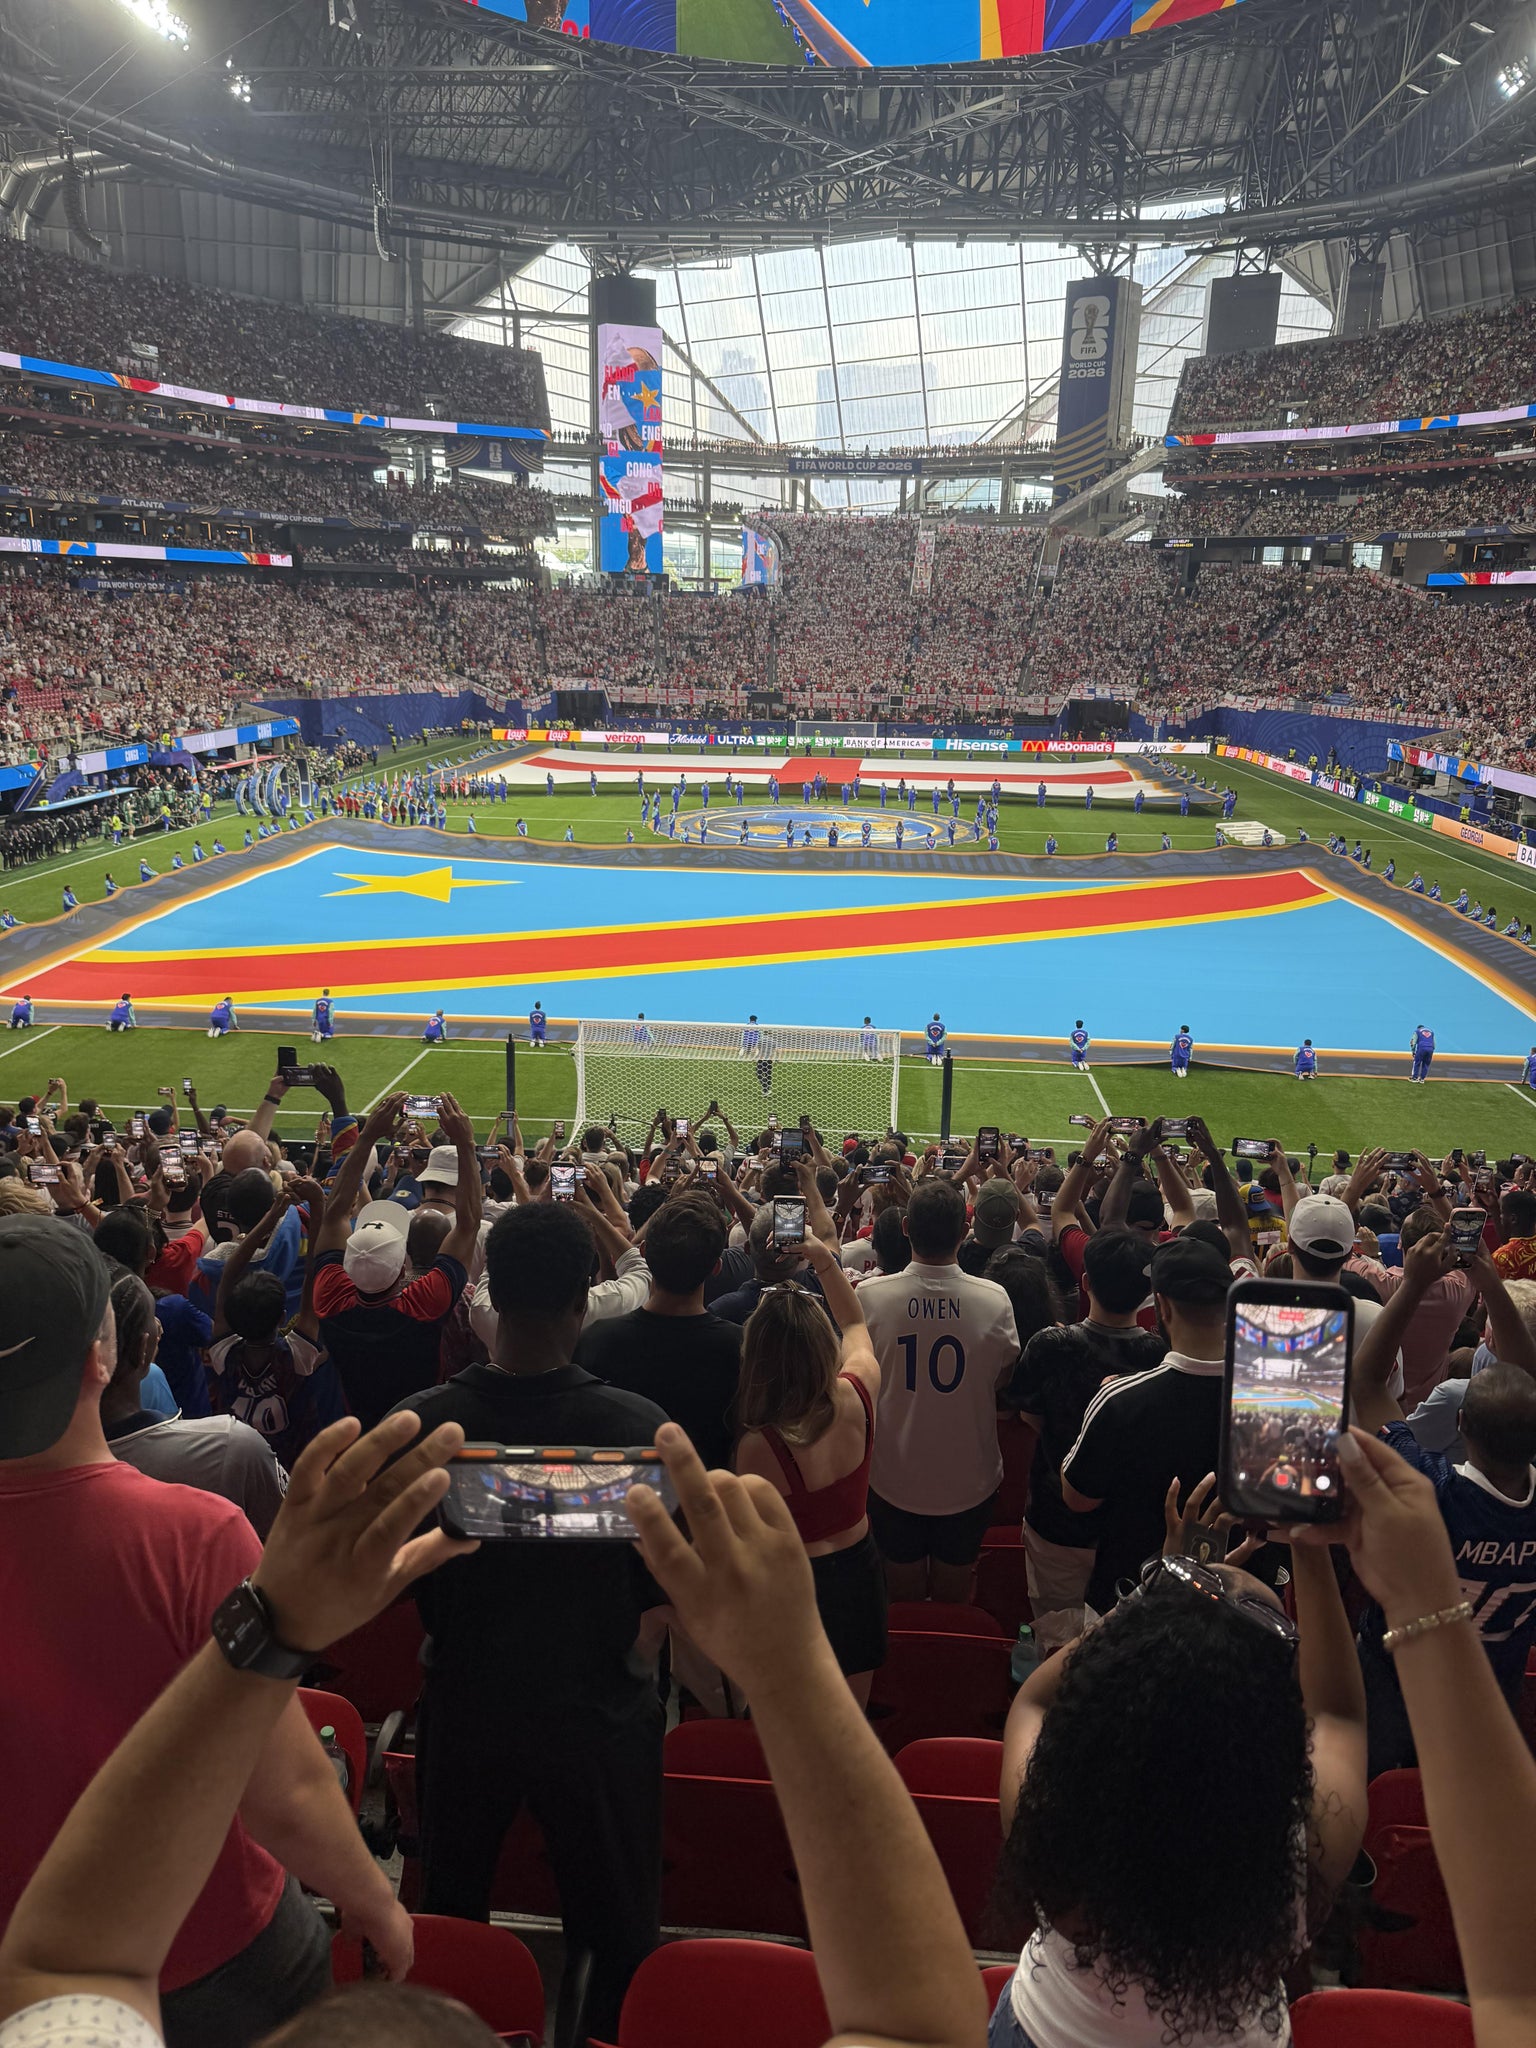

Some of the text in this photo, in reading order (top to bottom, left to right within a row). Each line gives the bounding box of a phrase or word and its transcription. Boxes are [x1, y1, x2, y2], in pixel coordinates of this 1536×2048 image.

[1080, 346, 1097, 355] FIFA
[1069, 360, 1106, 369] WORLD CUP
[1068, 368, 1106, 379] 2026
[796, 461, 913, 471] FIFA WORLD CUP 2026
[121, 498, 165, 510] ATLANTA
[260, 512, 271, 520] FIFA
[271, 513, 289, 521] WORLD
[418, 524, 464, 532] ATLANTA
[605, 732, 645, 743] verizon
[669, 733, 754, 745] Michelob ULTRA
[946, 739, 1008, 751] Hisense
[1047, 741, 1113, 752] McDonald's
[1138, 742, 1167, 753] Dove
[1460, 826, 1484, 845] GEORGIA
[908, 1297, 960, 1320] OWEN
[897, 1333, 966, 1394] 10
[1455, 1540, 1536, 1566] MBAP
